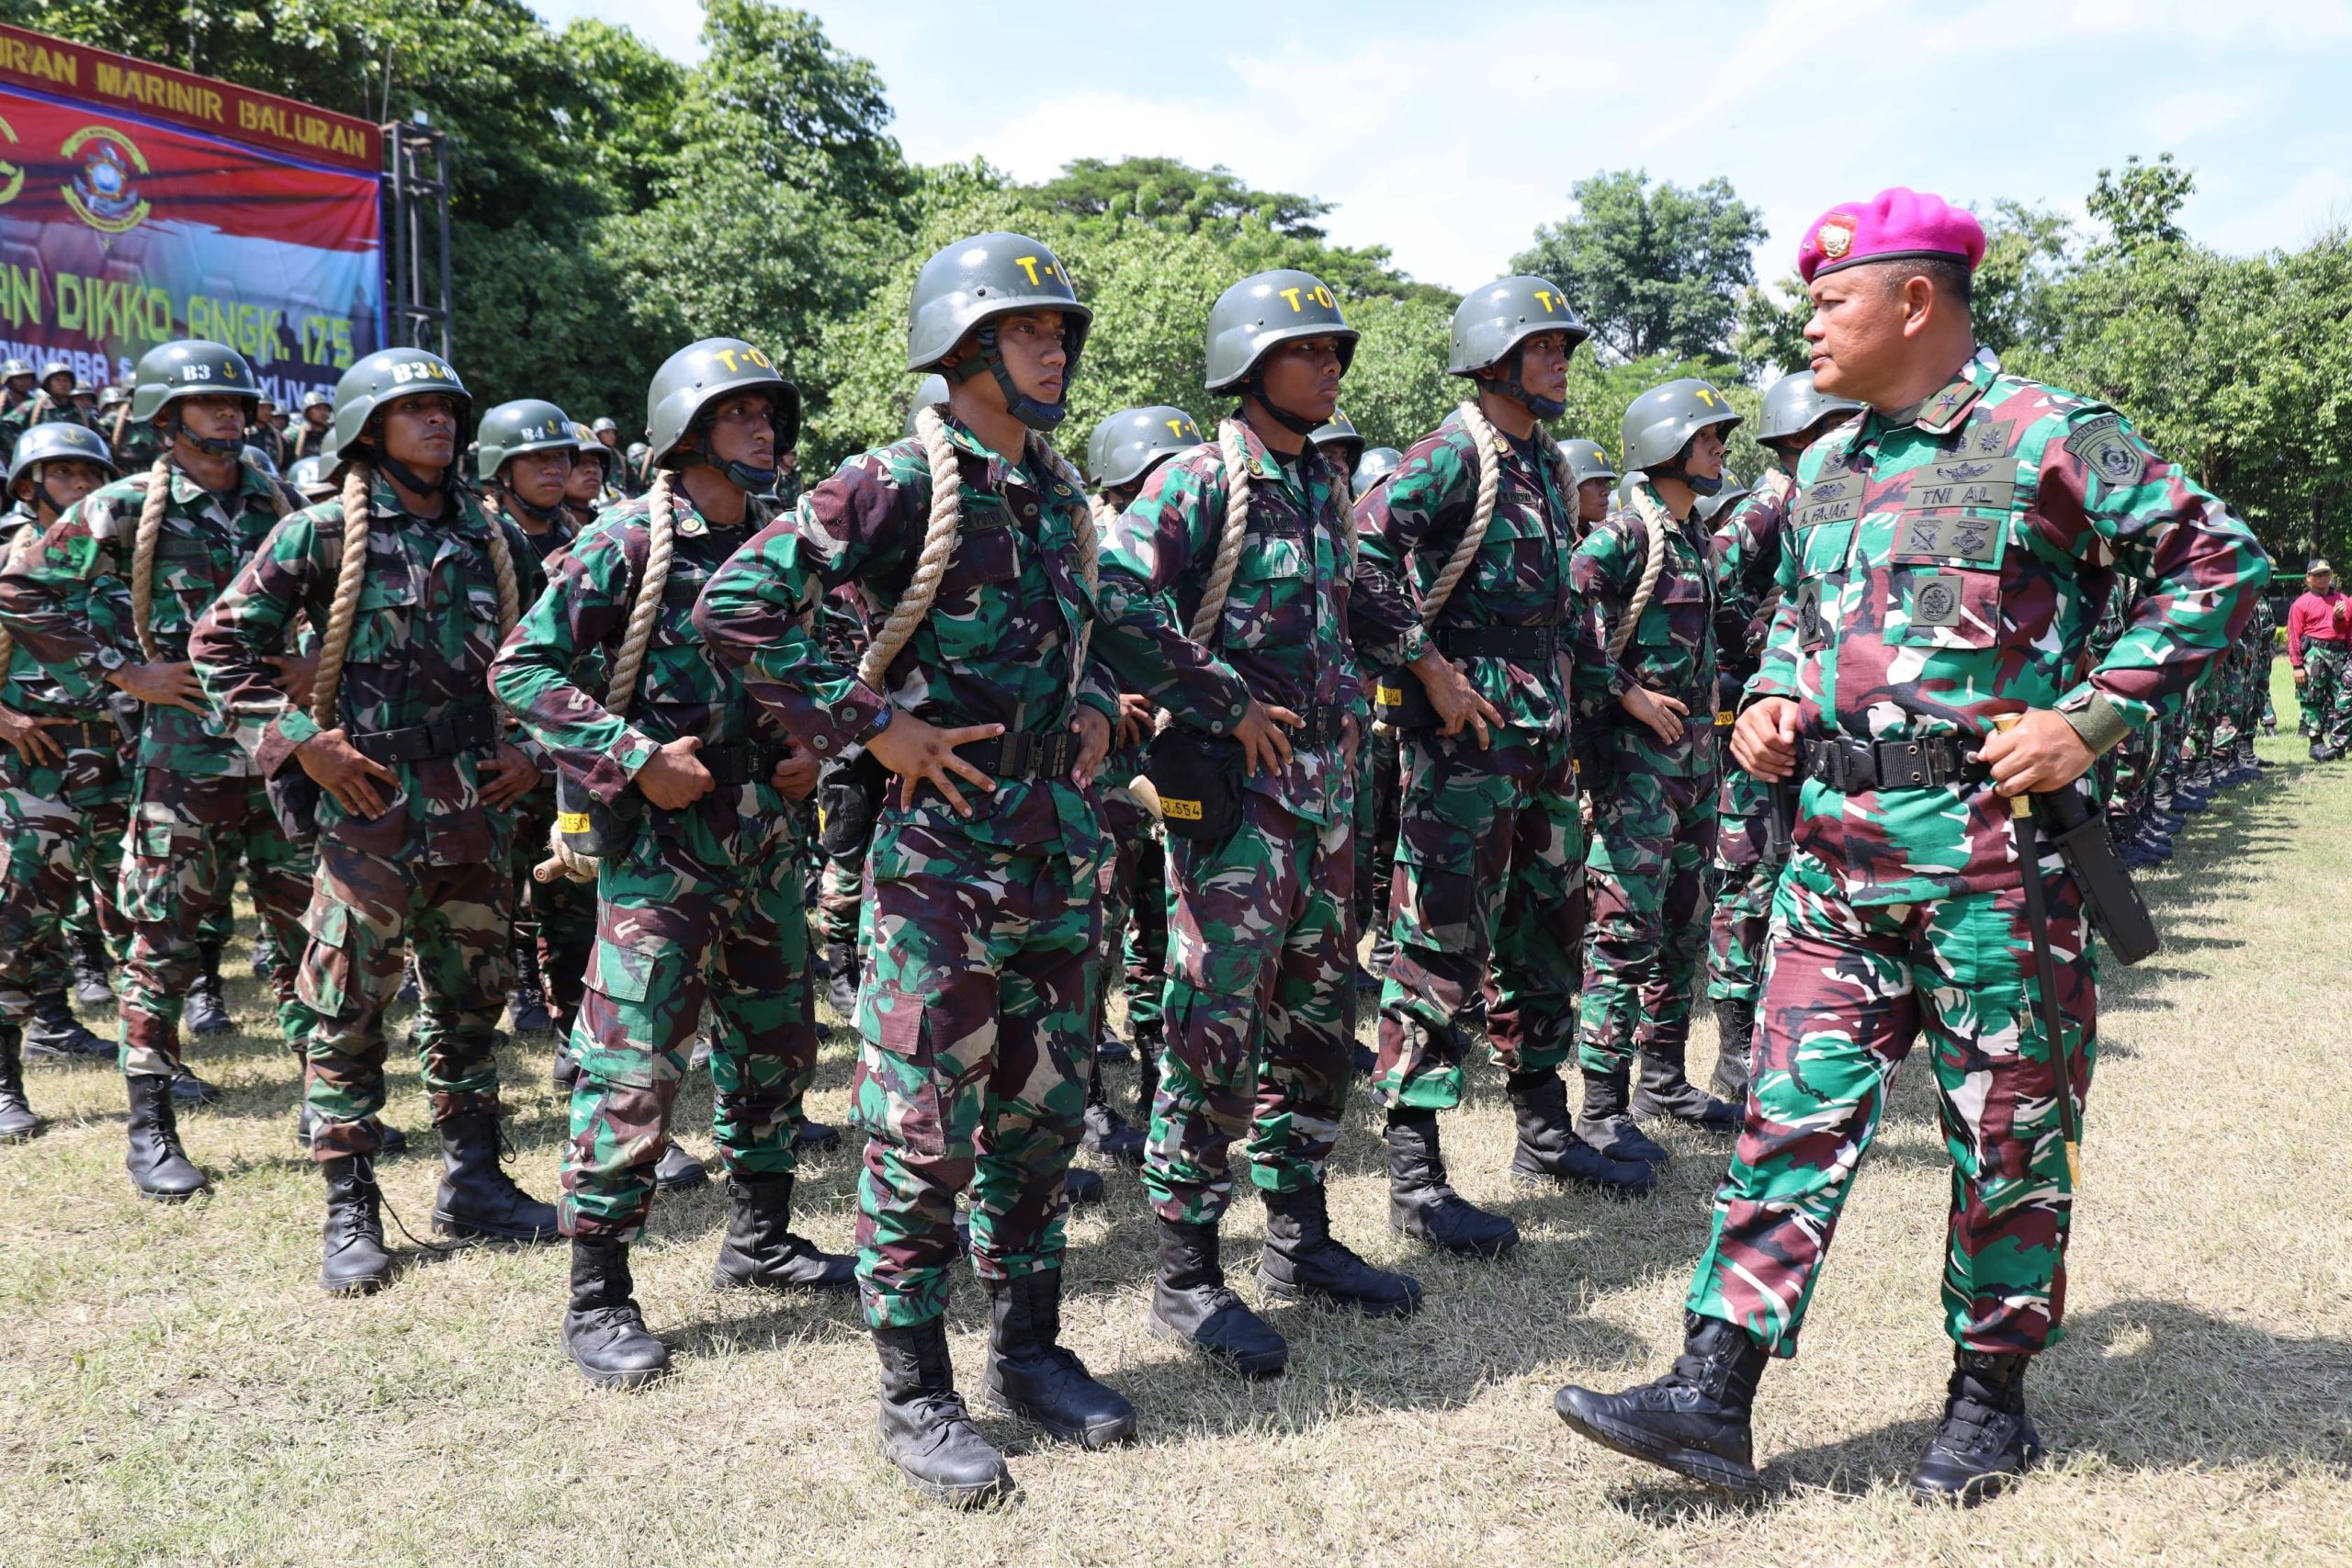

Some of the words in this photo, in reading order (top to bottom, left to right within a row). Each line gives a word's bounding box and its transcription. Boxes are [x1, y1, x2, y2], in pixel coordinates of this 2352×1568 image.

[96, 62, 224, 123] MARINIR
[239, 99, 366, 160] BALURAN
[56, 272, 172, 344] DIKKO
[187, 295, 290, 363] ANGK.
[303, 314, 354, 368] 175
[183, 365, 210, 380] B3
[391, 361, 429, 384] B3
[1922, 488, 1954, 504] TNI
[1962, 486, 1993, 502] AL
[1811, 502, 1849, 522] FAJAR
